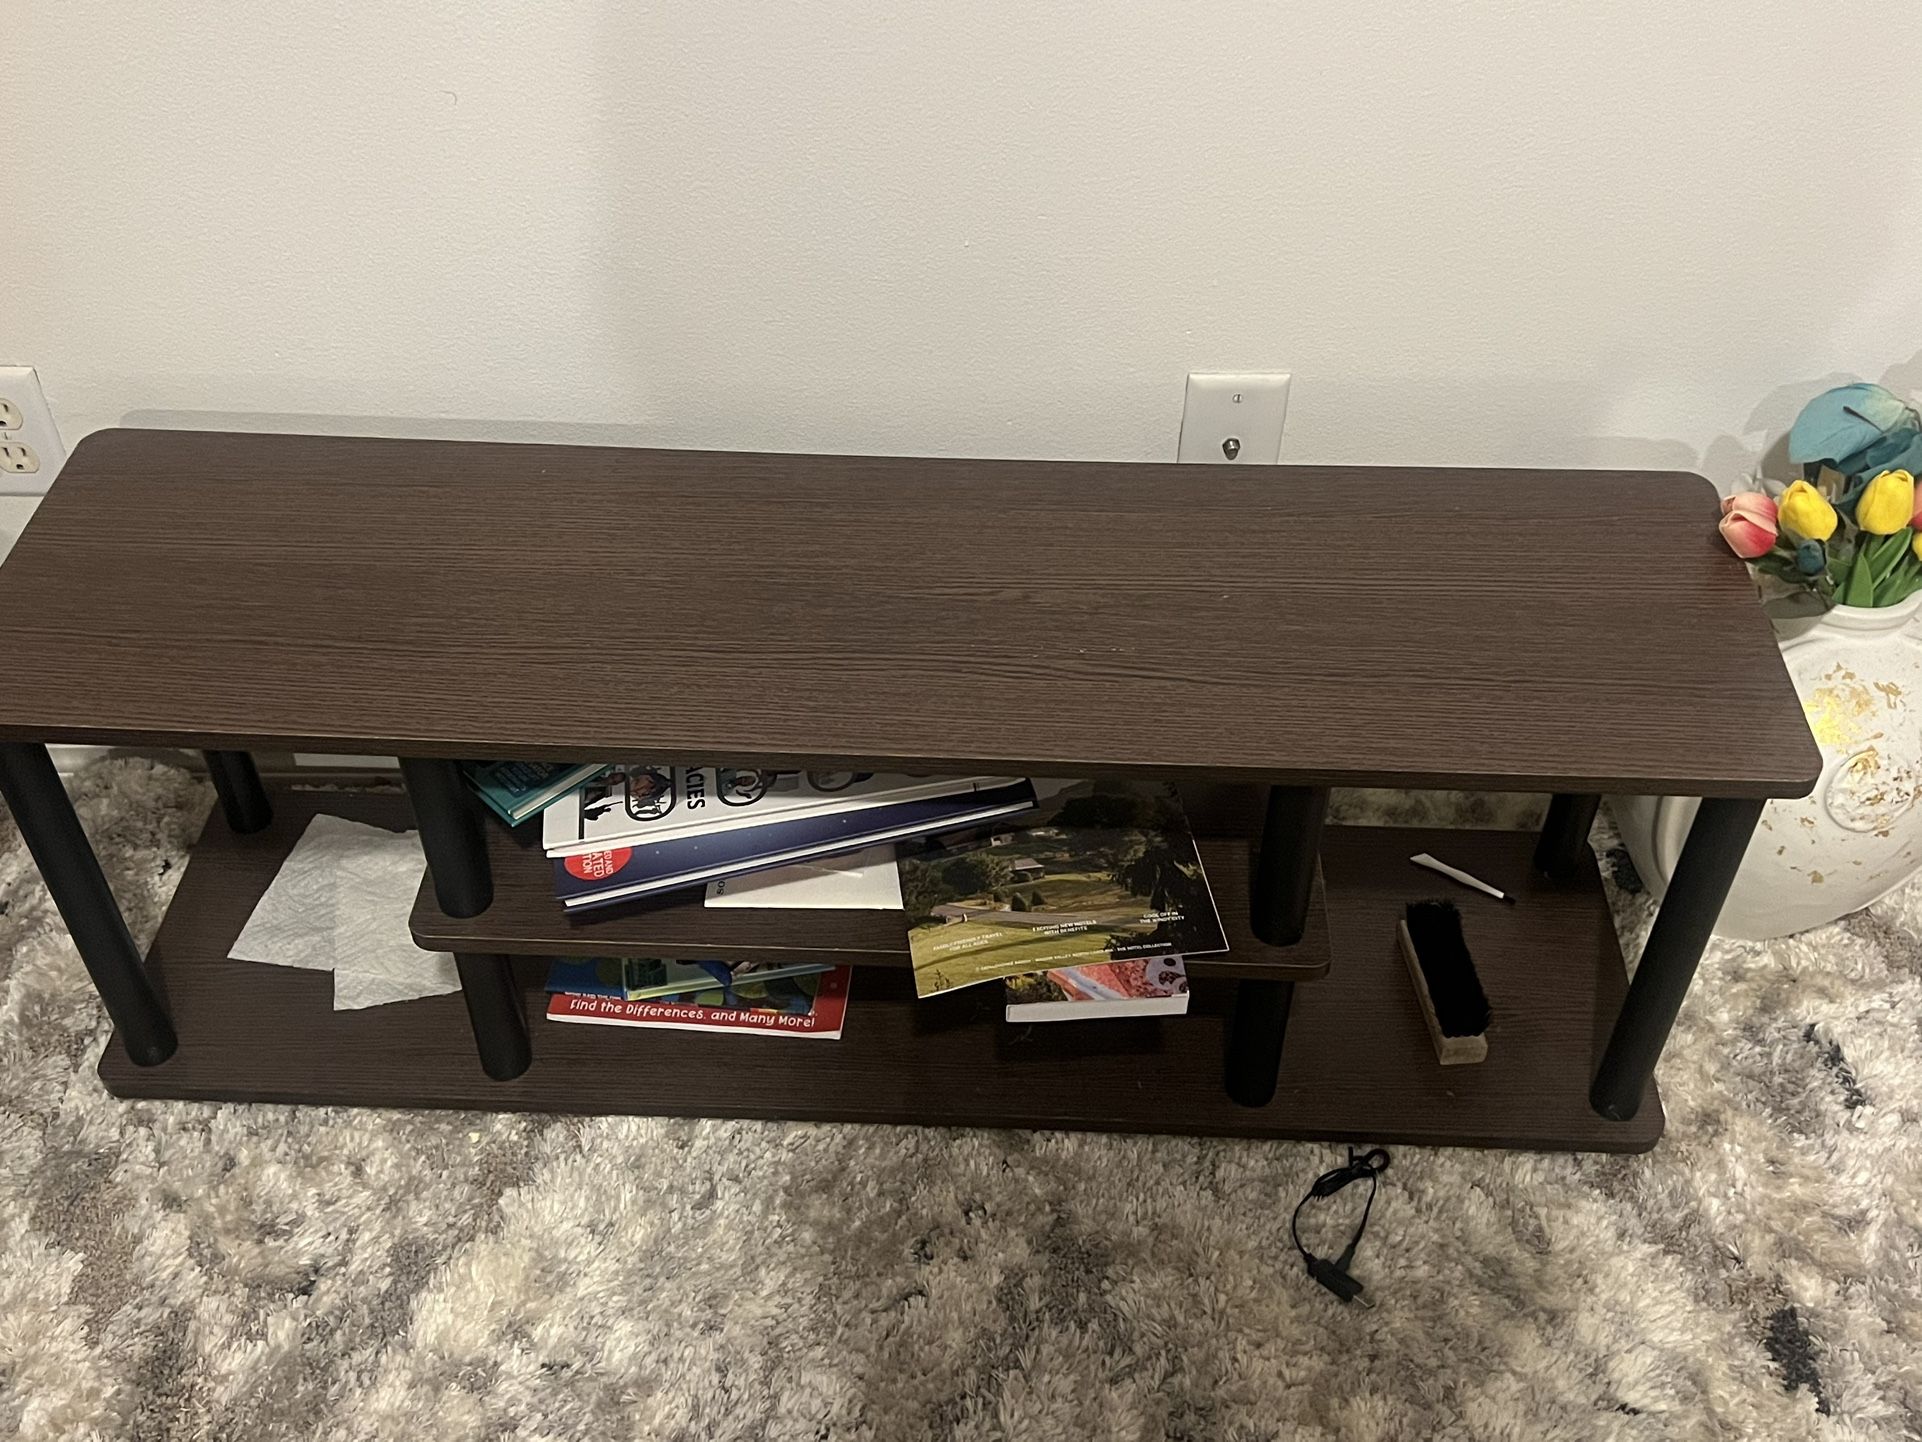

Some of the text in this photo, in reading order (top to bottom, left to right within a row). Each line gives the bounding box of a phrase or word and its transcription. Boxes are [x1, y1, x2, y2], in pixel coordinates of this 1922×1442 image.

[582, 854, 593, 874] TION
[592, 852, 605, 877] ATED
[604, 860, 614, 875] AND
[981, 932, 1003, 940] TRAVEL
[570, 999, 598, 1011] Find
[600, 1001, 622, 1013] the
[711, 1011, 736, 1021] and
[739, 1012, 775, 1026] Many
[778, 1015, 815, 1027] More!
